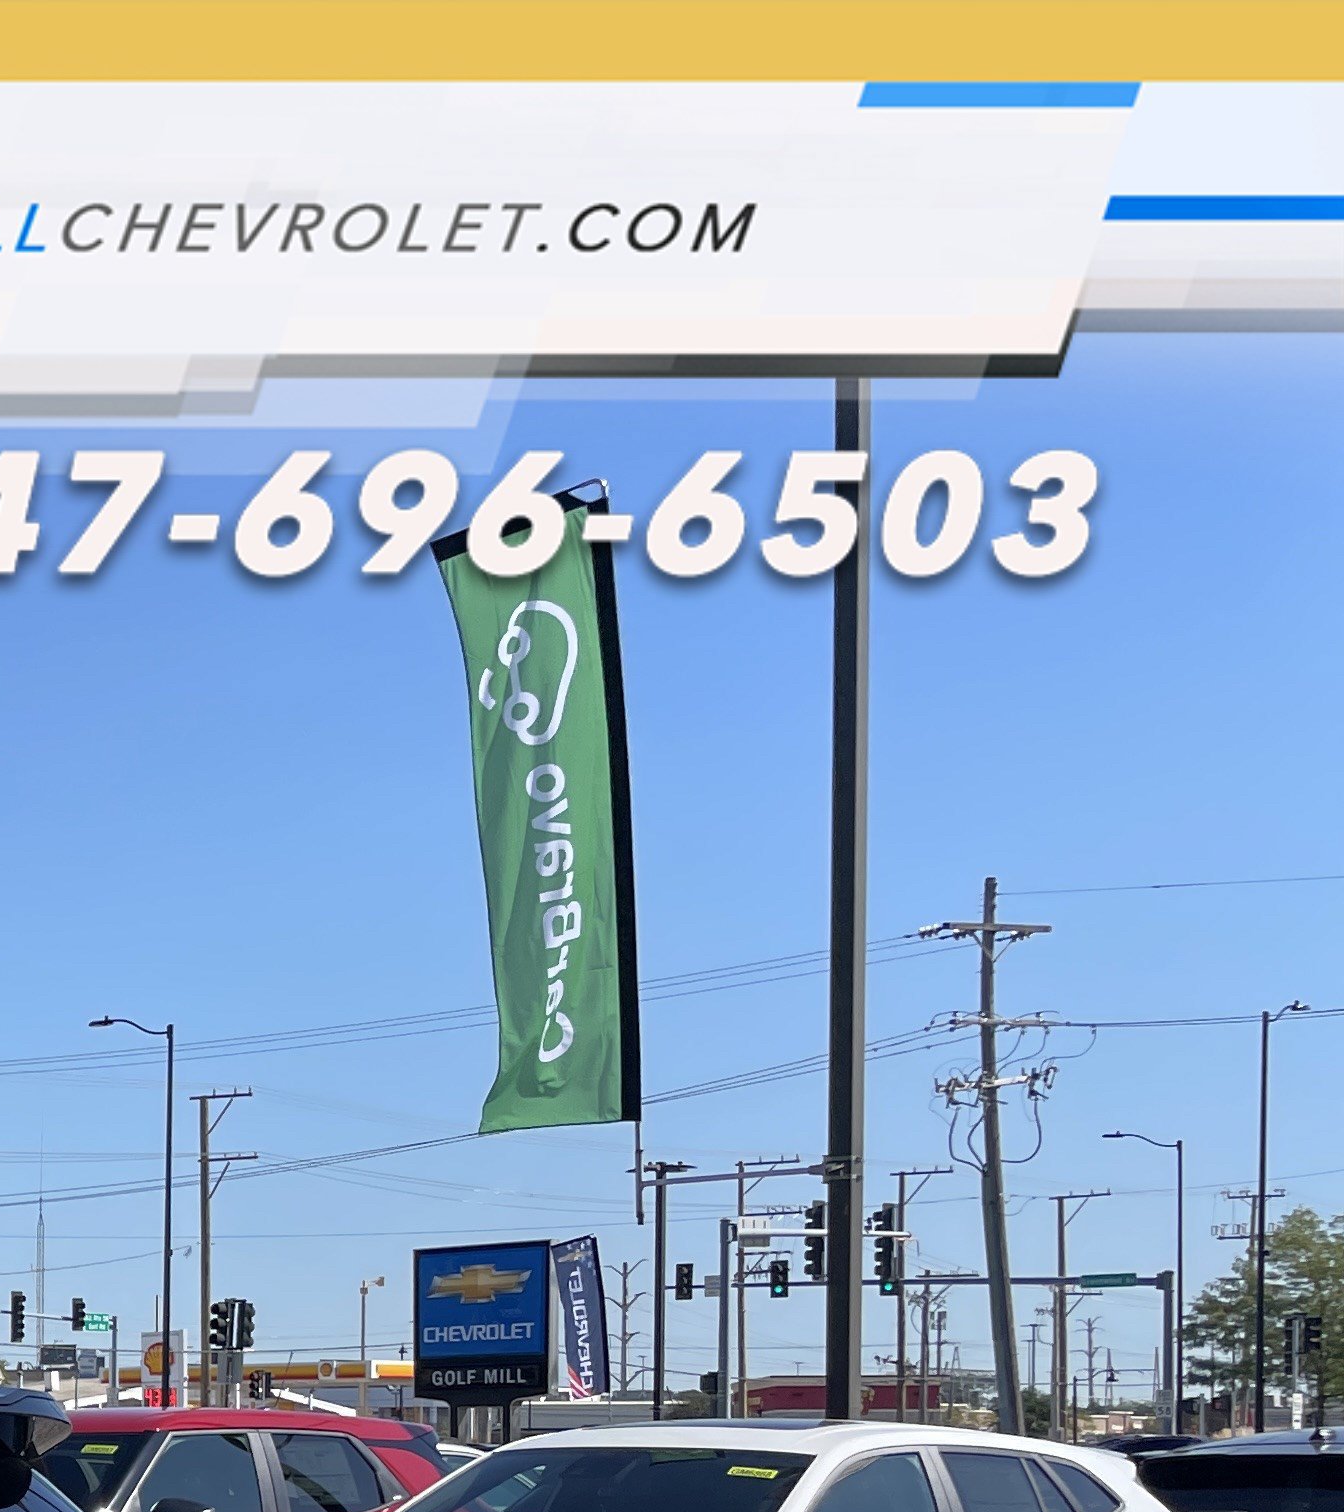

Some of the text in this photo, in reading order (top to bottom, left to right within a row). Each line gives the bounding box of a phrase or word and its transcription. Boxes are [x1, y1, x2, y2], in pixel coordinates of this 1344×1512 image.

[423, 1322, 536, 1344] CHEVROLET
[431, 1368, 527, 1387] GOLF MILL
